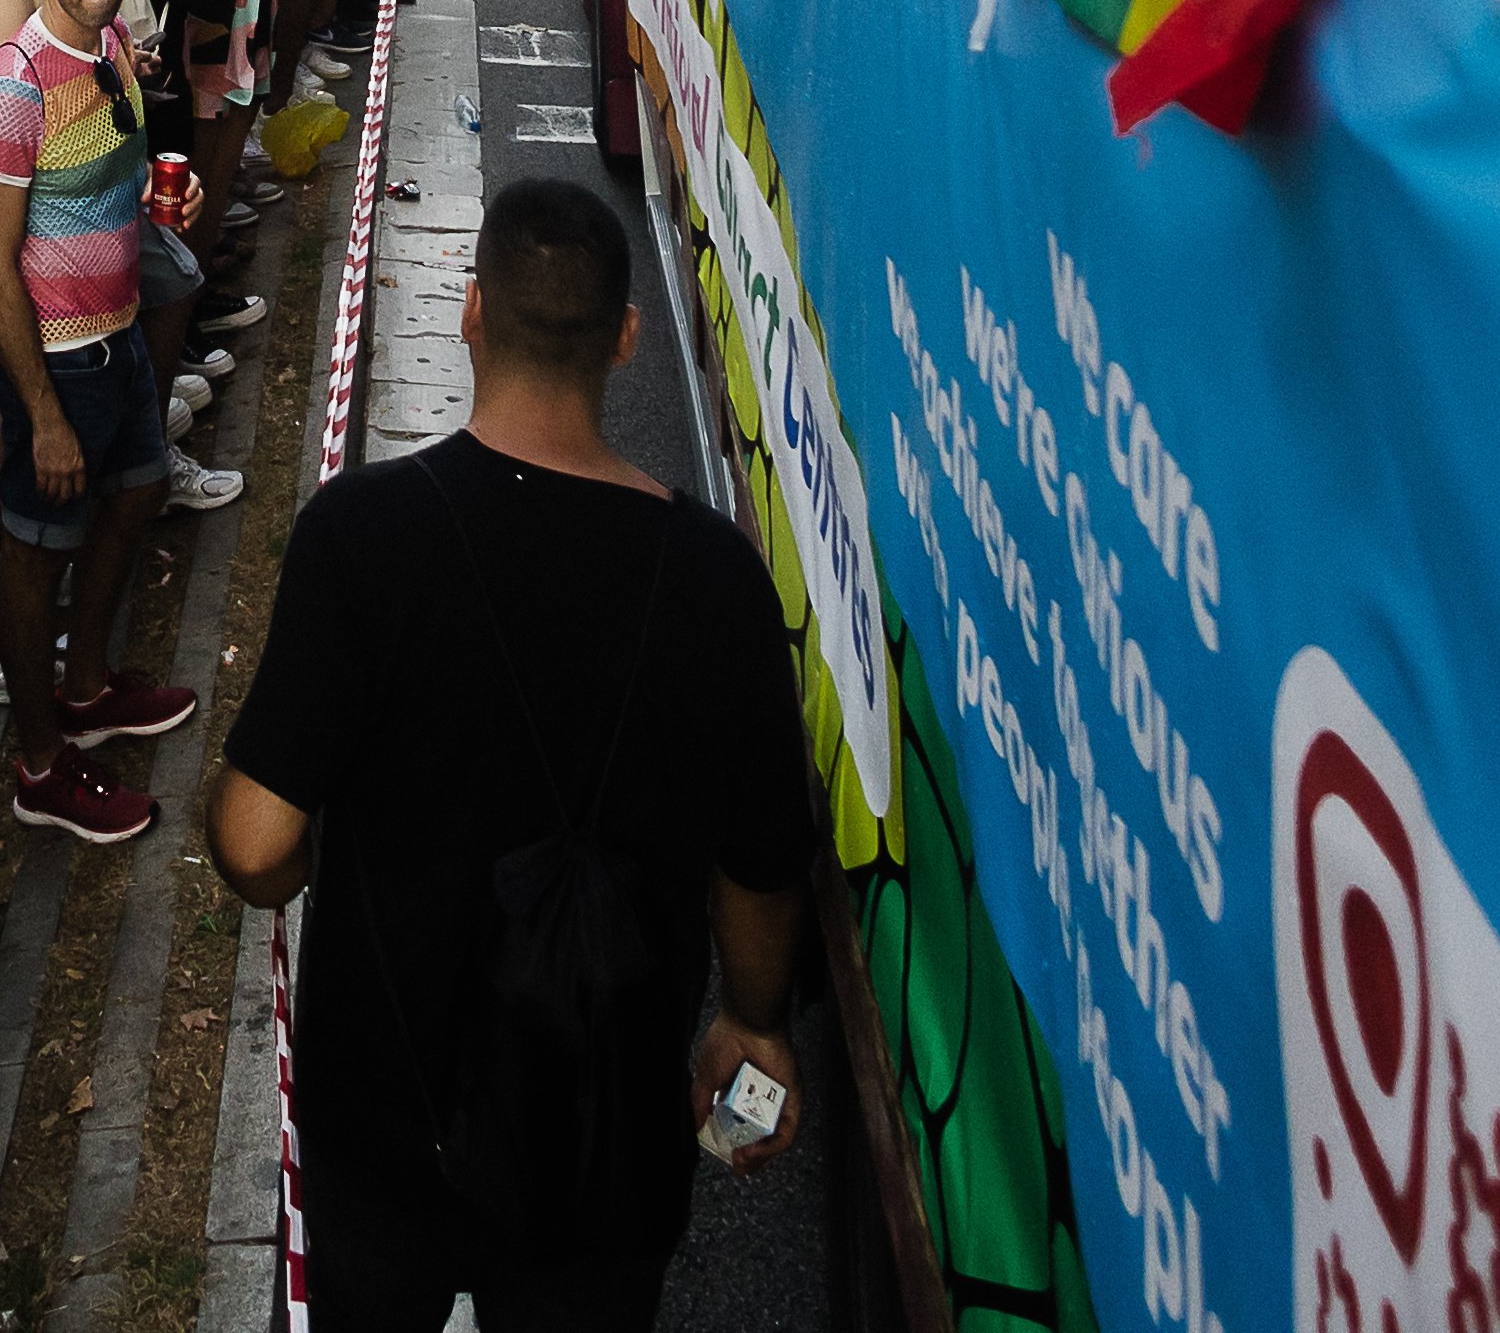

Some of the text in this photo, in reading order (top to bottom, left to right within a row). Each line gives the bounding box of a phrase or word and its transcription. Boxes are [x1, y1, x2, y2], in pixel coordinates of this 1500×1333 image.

[921, 349, 1041, 667] achieve
[1105, 358, 1221, 654] care
[956, 597, 1073, 962] people
